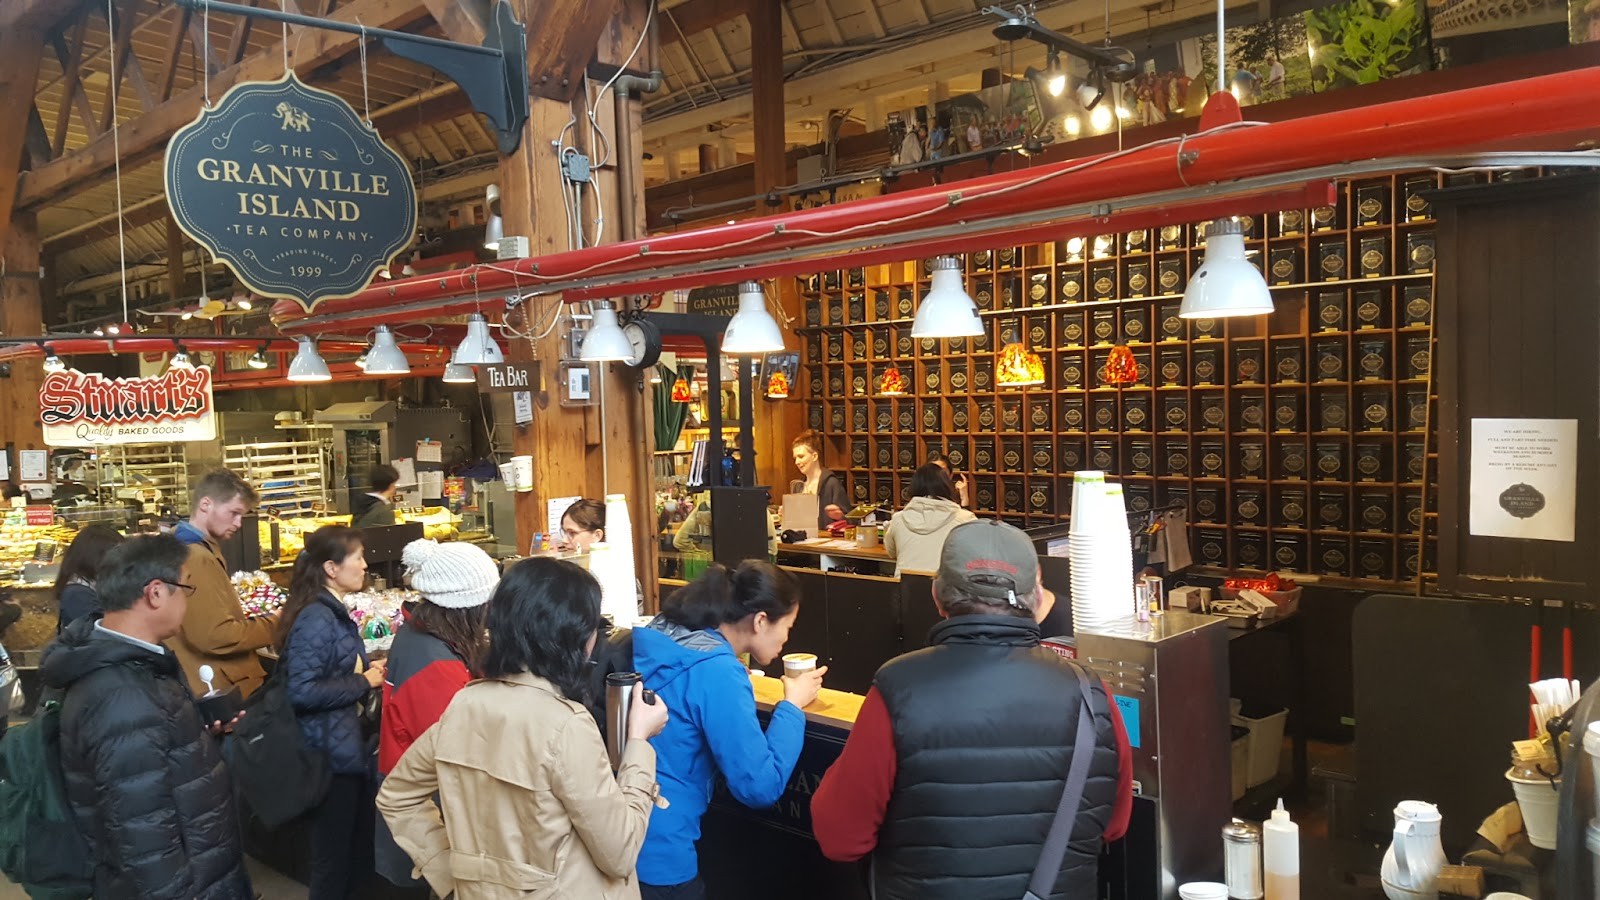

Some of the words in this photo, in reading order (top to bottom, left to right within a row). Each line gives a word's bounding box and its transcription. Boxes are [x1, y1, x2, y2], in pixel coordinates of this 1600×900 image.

[280, 144, 313, 159] THE
[197, 158, 390, 196] GRANVILLE
[237, 192, 361, 223] ISLAND
[233, 224, 268, 237] TEA
[280, 226, 369, 243] COMPANY
[290, 265, 322, 278] 1999
[693, 295, 740, 310] GRANVIL
[487, 367, 506, 387] TEA
[507, 366, 529, 387] BAR
[39, 367, 211, 425] Stuart's
[75, 422, 114, 442] Quality
[118, 427, 149, 436] BAKED
[152, 425, 185, 435] GOODS
